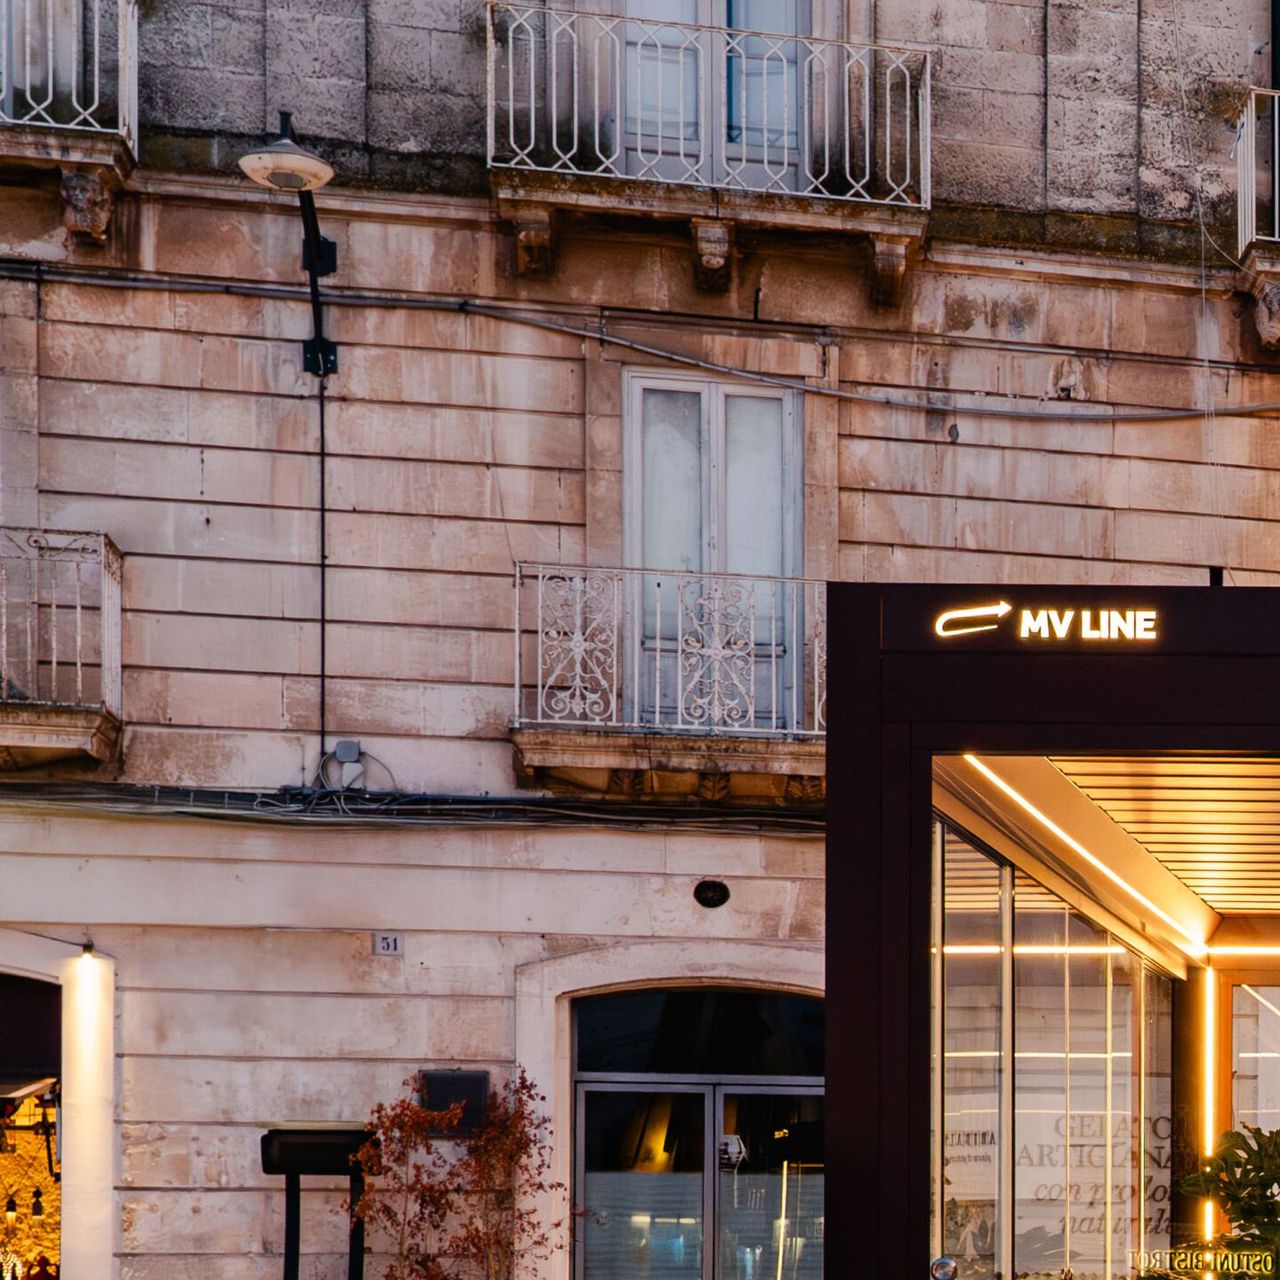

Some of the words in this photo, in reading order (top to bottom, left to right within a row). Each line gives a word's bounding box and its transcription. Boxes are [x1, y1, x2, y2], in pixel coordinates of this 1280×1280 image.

[1020, 610, 1074, 638] MV
[1081, 610, 1157, 639] LINE
[381, 936, 398, 951] 51
